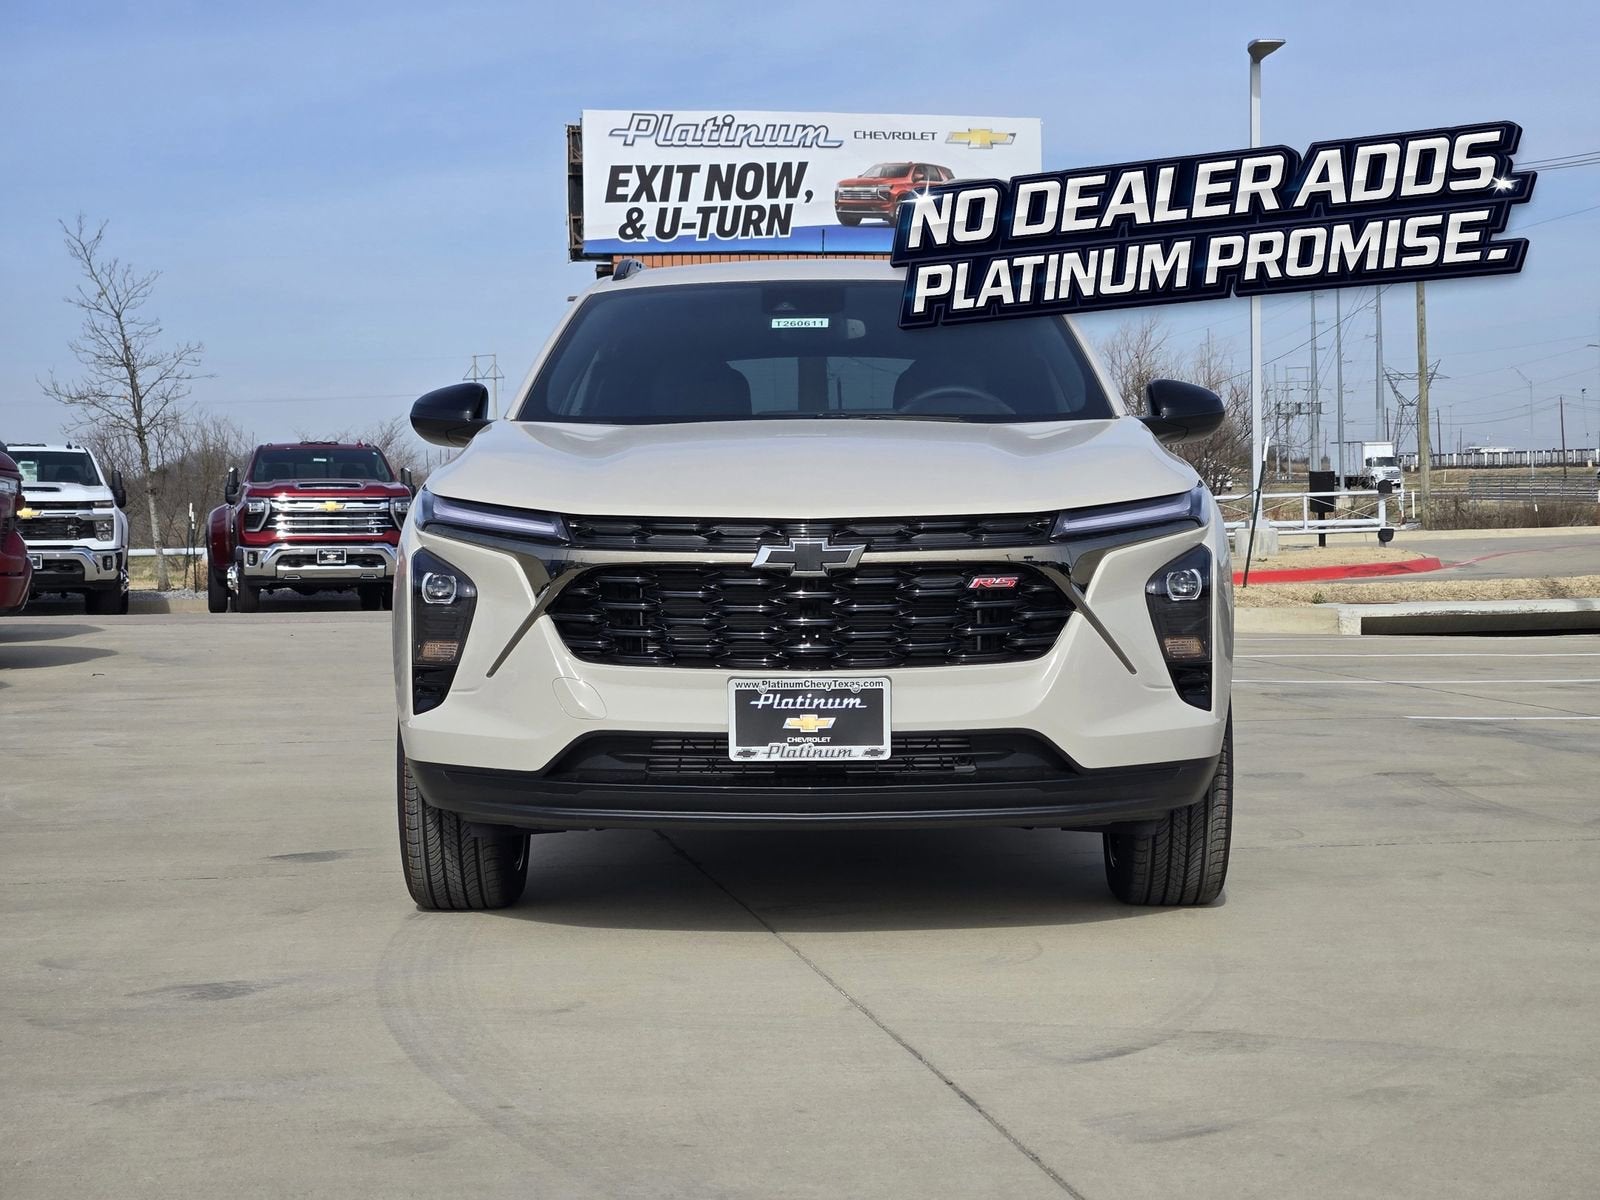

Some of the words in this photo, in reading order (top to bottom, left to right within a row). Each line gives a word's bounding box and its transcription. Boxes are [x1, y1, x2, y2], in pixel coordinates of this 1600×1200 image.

[608, 112, 844, 150] Platinum
[853, 130, 938, 142] CHEVROLET
[604, 163, 701, 204] EXIT
[704, 160, 815, 204] NOW,
[617, 207, 648, 240] &
[654, 203, 794, 239] U-TURN
[968, 577, 1018, 588] RS
[735, 680, 884, 690] wwwPlatinumChevyTexas.com
[750, 693, 867, 709] Platinum
[763, 745, 857, 758] Platinum
